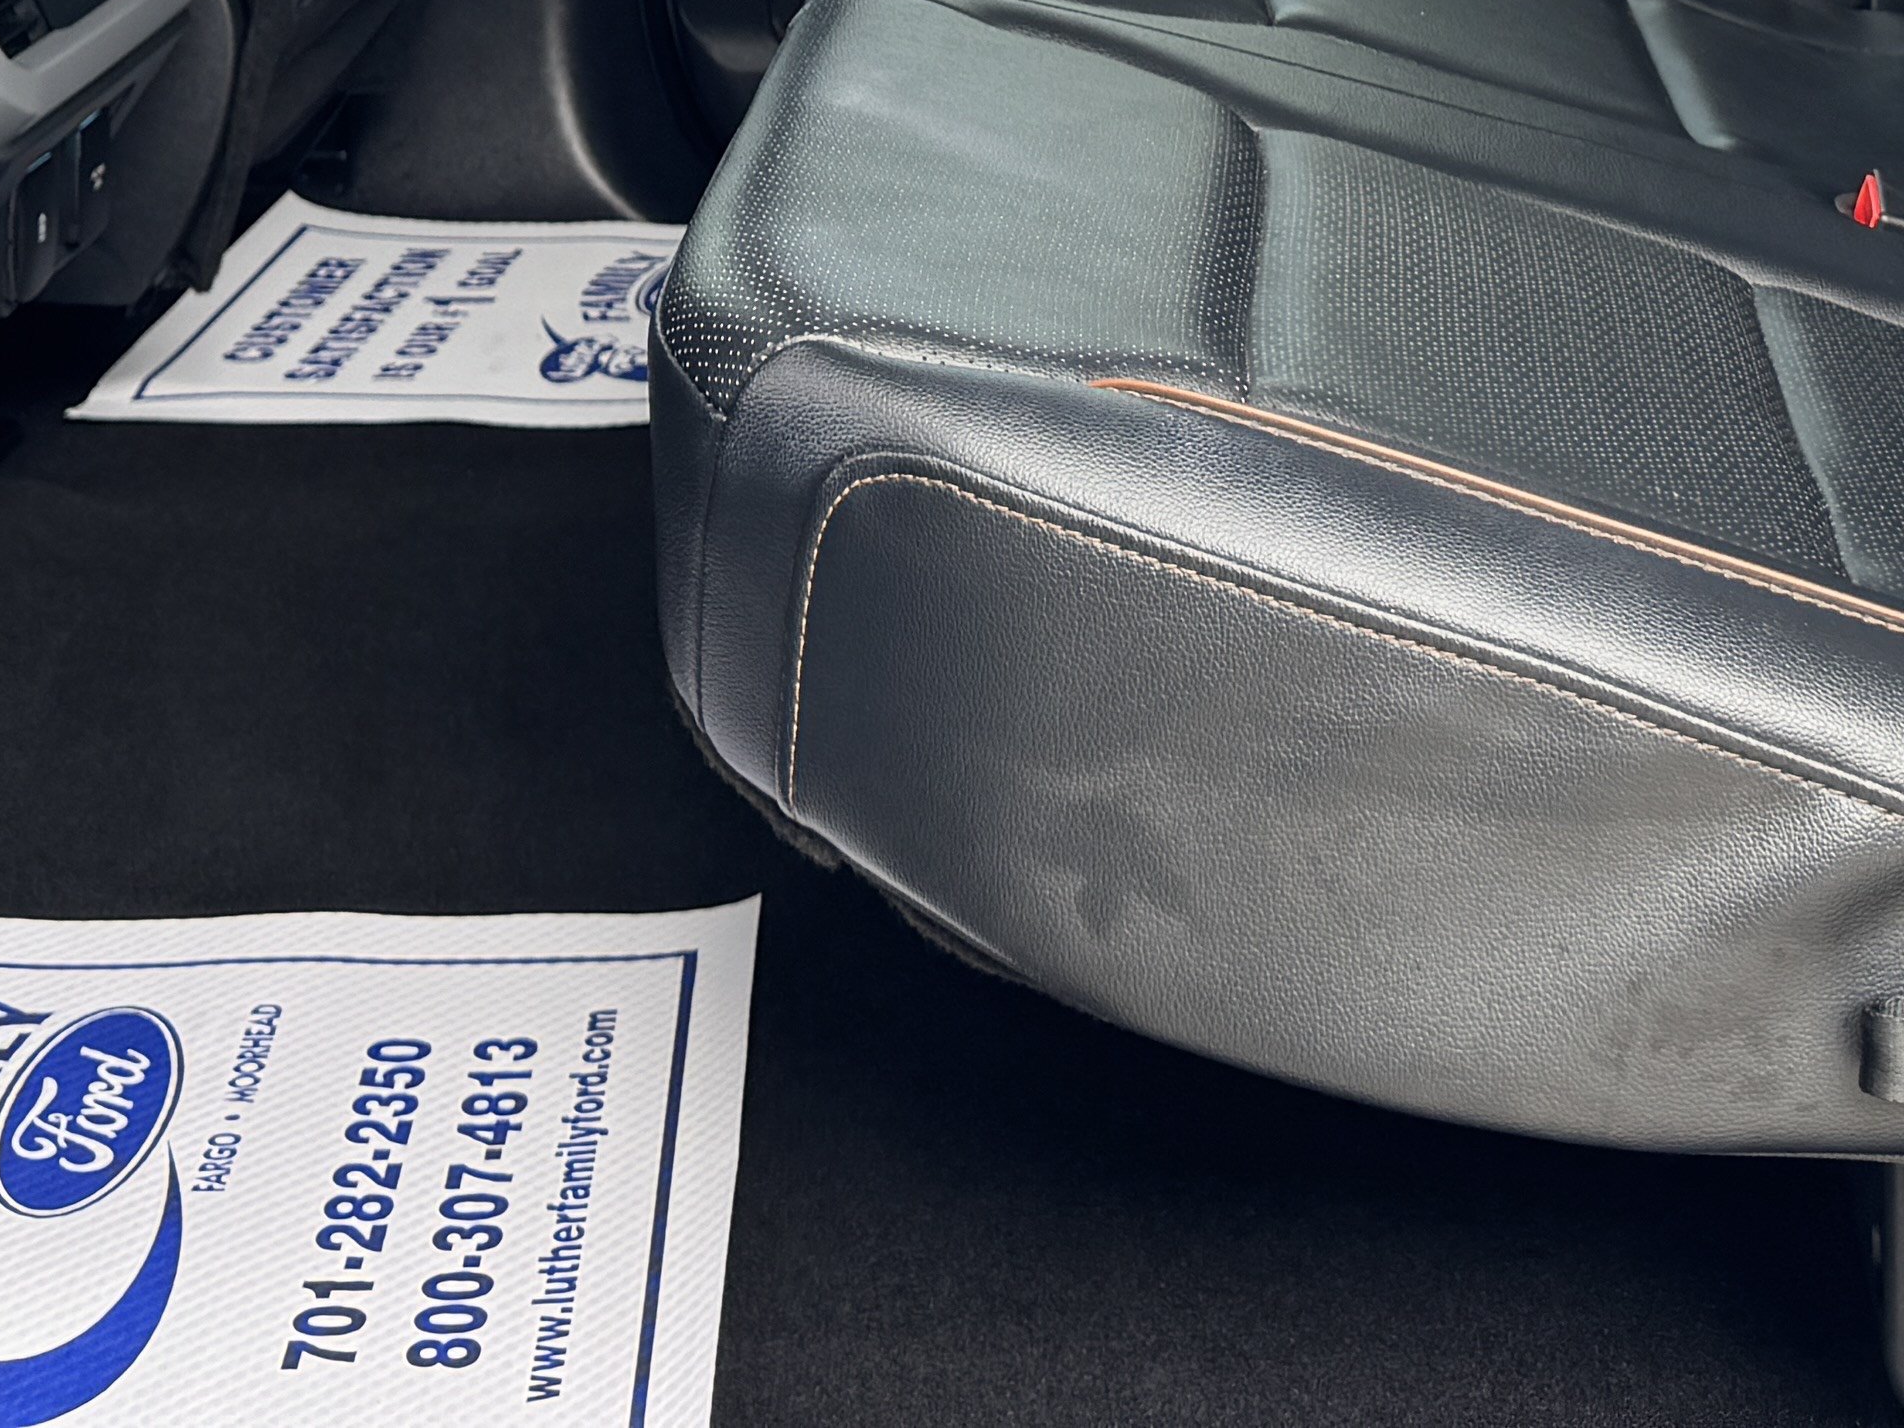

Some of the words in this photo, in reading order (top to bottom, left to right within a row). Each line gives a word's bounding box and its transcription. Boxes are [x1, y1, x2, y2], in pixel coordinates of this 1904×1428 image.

[223, 256, 367, 362] CUSTOMER
[284, 246, 451, 380] SATISFACTION
[457, 247, 524, 288] GOAL
[579, 250, 668, 322] FAMILY
[372, 362, 424, 382] IS
[396, 321, 461, 358] OUR
[11, 1045, 151, 1174] Ford
[191, 1132, 242, 1192] FARGO
[224, 1004, 282, 1103] MOORHEAD
[281, 1038, 432, 1370] 701-282-2350
[406, 1037, 538, 1369] 800-307-4813
[526, 1008, 617, 1403] www.lutherfamilyford.com
